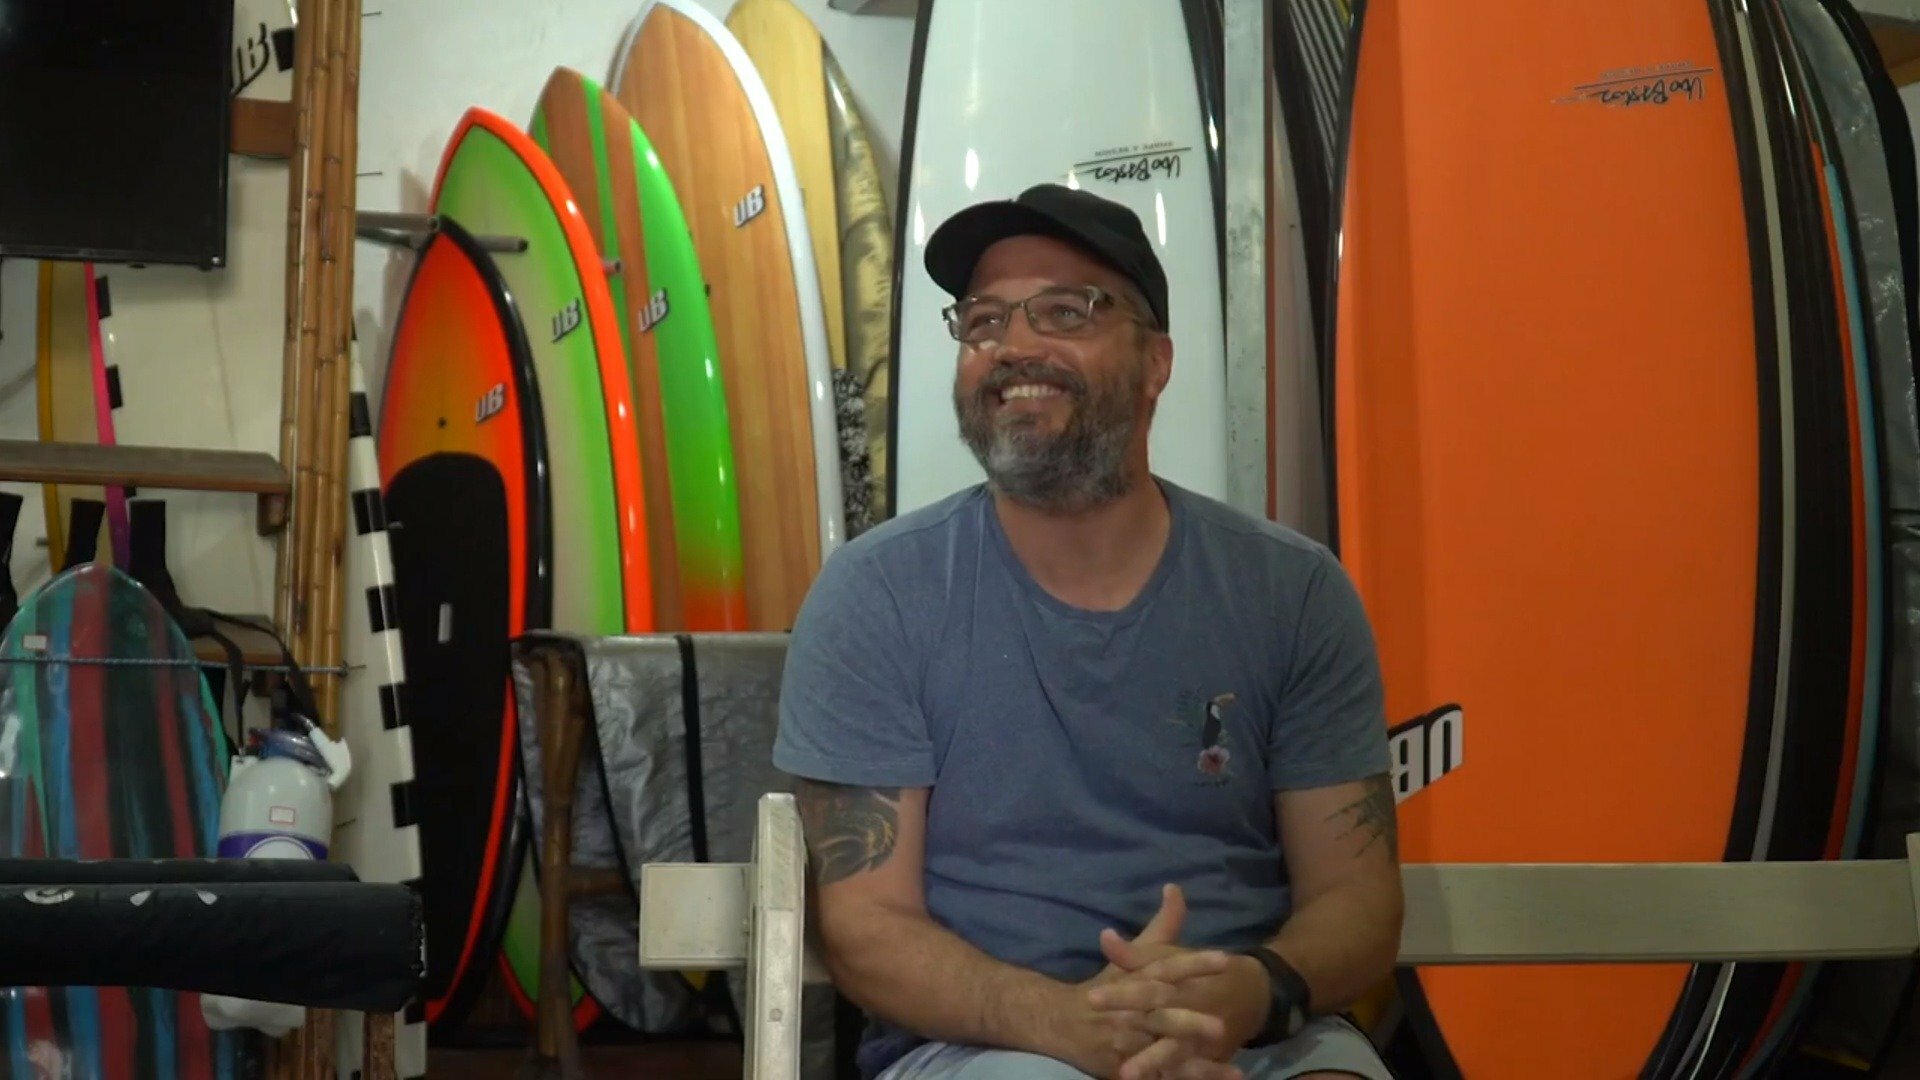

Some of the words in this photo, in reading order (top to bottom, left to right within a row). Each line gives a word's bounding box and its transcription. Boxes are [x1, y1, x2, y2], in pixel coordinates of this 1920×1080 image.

[733, 184, 766, 229] UB
[552, 297, 581, 343] UB
[638, 288, 670, 333] UB
[475, 382, 505, 424] UB
